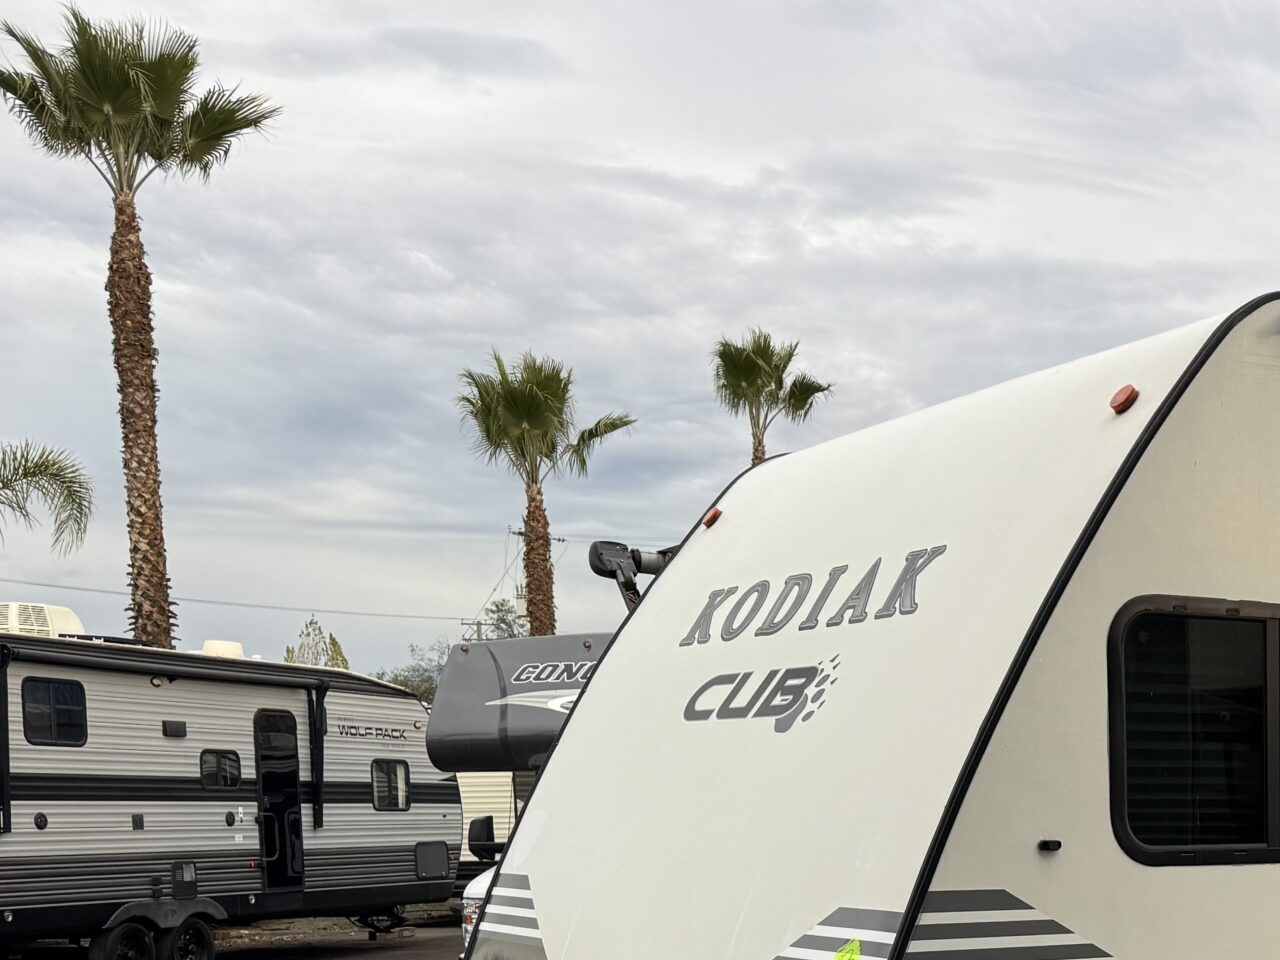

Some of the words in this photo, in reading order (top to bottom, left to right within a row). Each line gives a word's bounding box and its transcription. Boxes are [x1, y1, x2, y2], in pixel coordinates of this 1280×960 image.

[679, 544, 948, 648] KODIAK
[684, 665, 820, 722] CUB
[337, 724, 374, 737] WOLF
[375, 727, 408, 740] PACK
